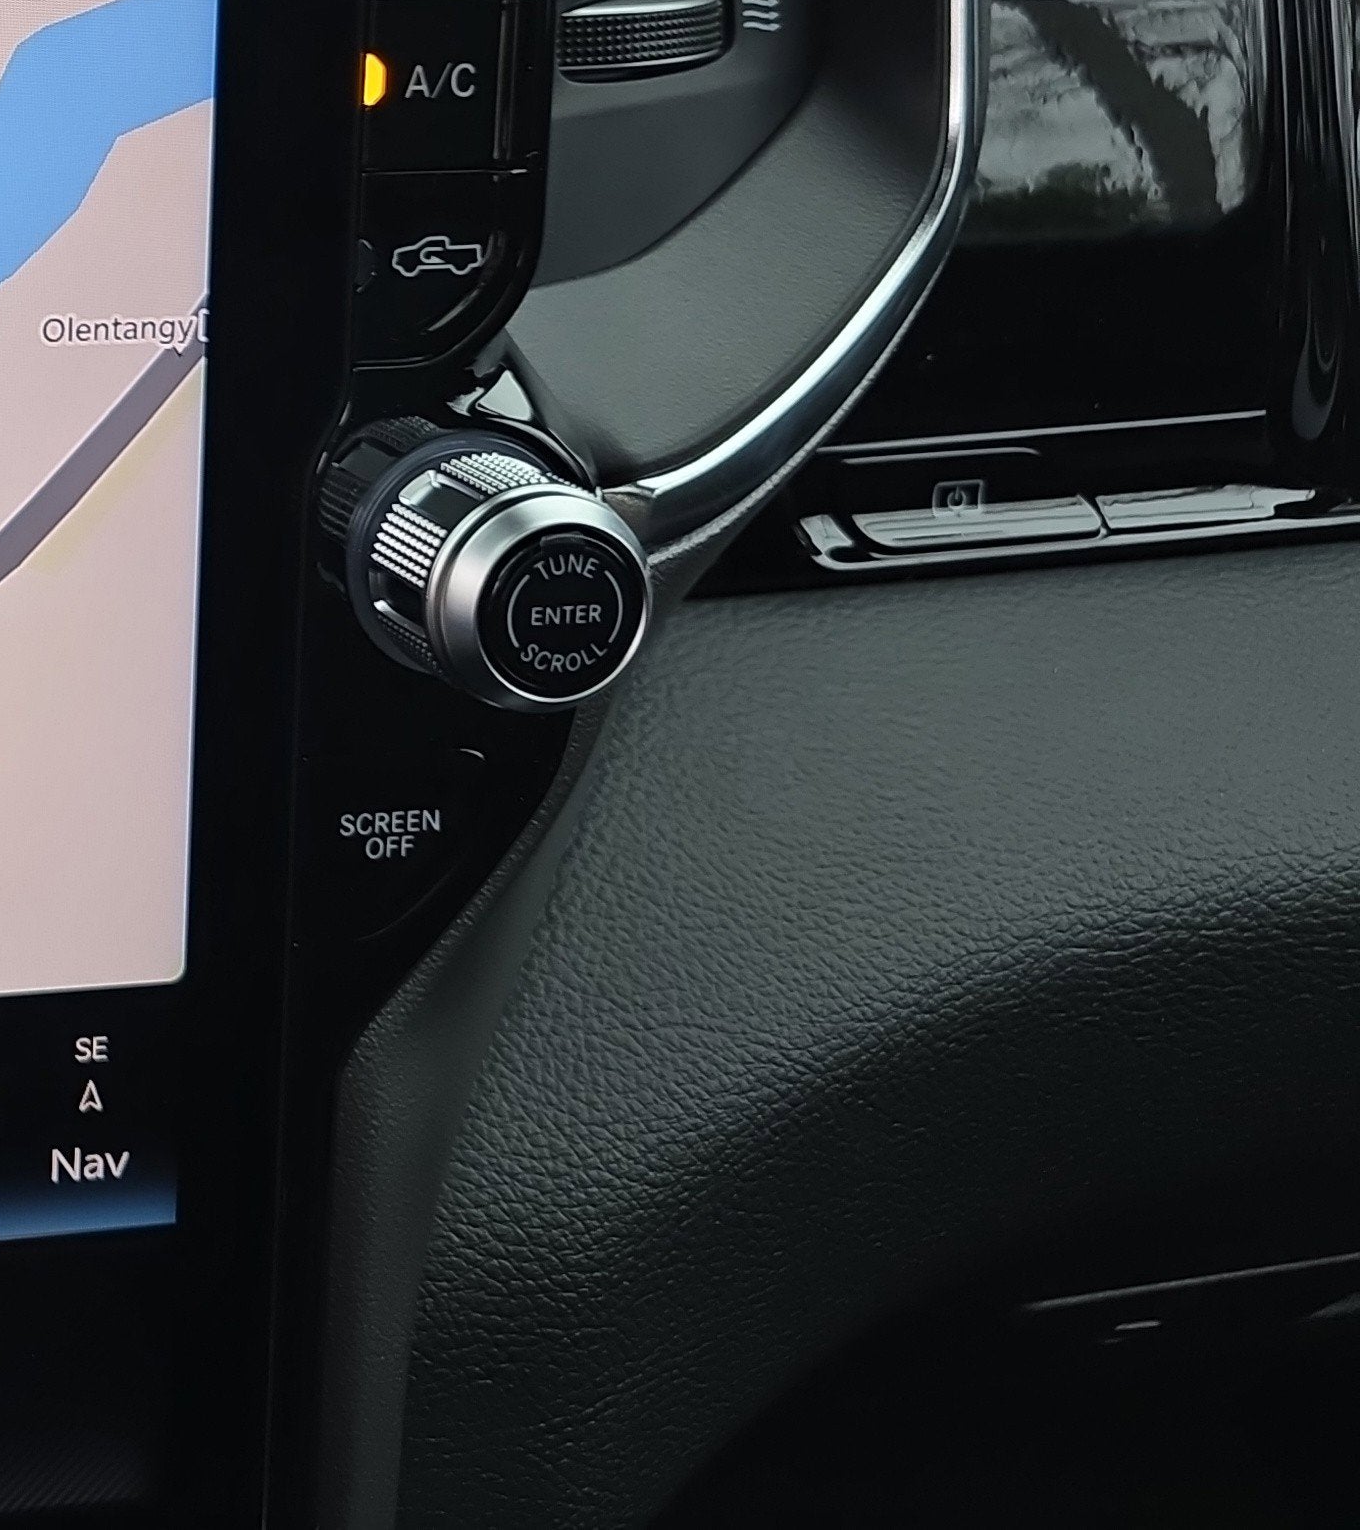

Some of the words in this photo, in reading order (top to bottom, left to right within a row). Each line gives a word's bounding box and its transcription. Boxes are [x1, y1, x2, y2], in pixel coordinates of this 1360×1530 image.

[404, 62, 476, 99] A/C
[42, 316, 195, 346] Olentangy
[533, 553, 600, 581] TUNE
[530, 604, 602, 626] ENTER
[520, 642, 608, 673] SCROLL
[339, 809, 441, 837] SCREEN
[365, 835, 415, 860] OFF
[74, 1035, 108, 1062] SE
[51, 1147, 130, 1183] Nav
